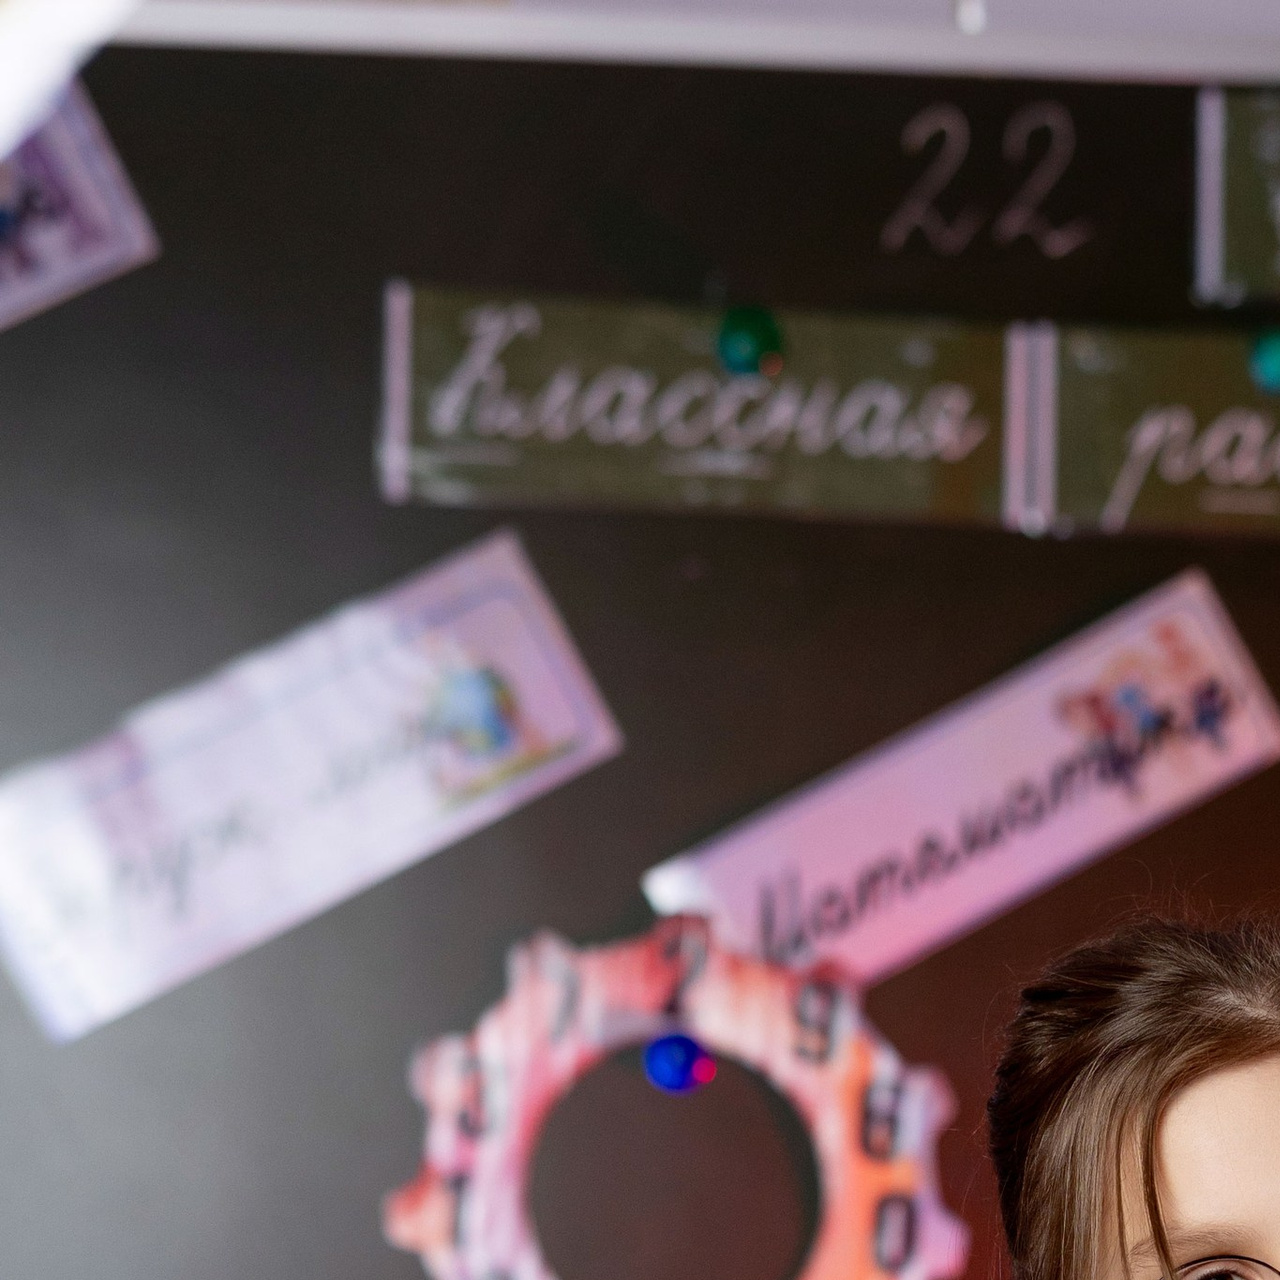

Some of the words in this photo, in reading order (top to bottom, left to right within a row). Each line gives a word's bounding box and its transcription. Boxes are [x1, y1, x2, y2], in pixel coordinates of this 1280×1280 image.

[878, 102, 1094, 262] 22
[426, 303, 988, 461] Классная
[876, 1194, 916, 1274] 0
